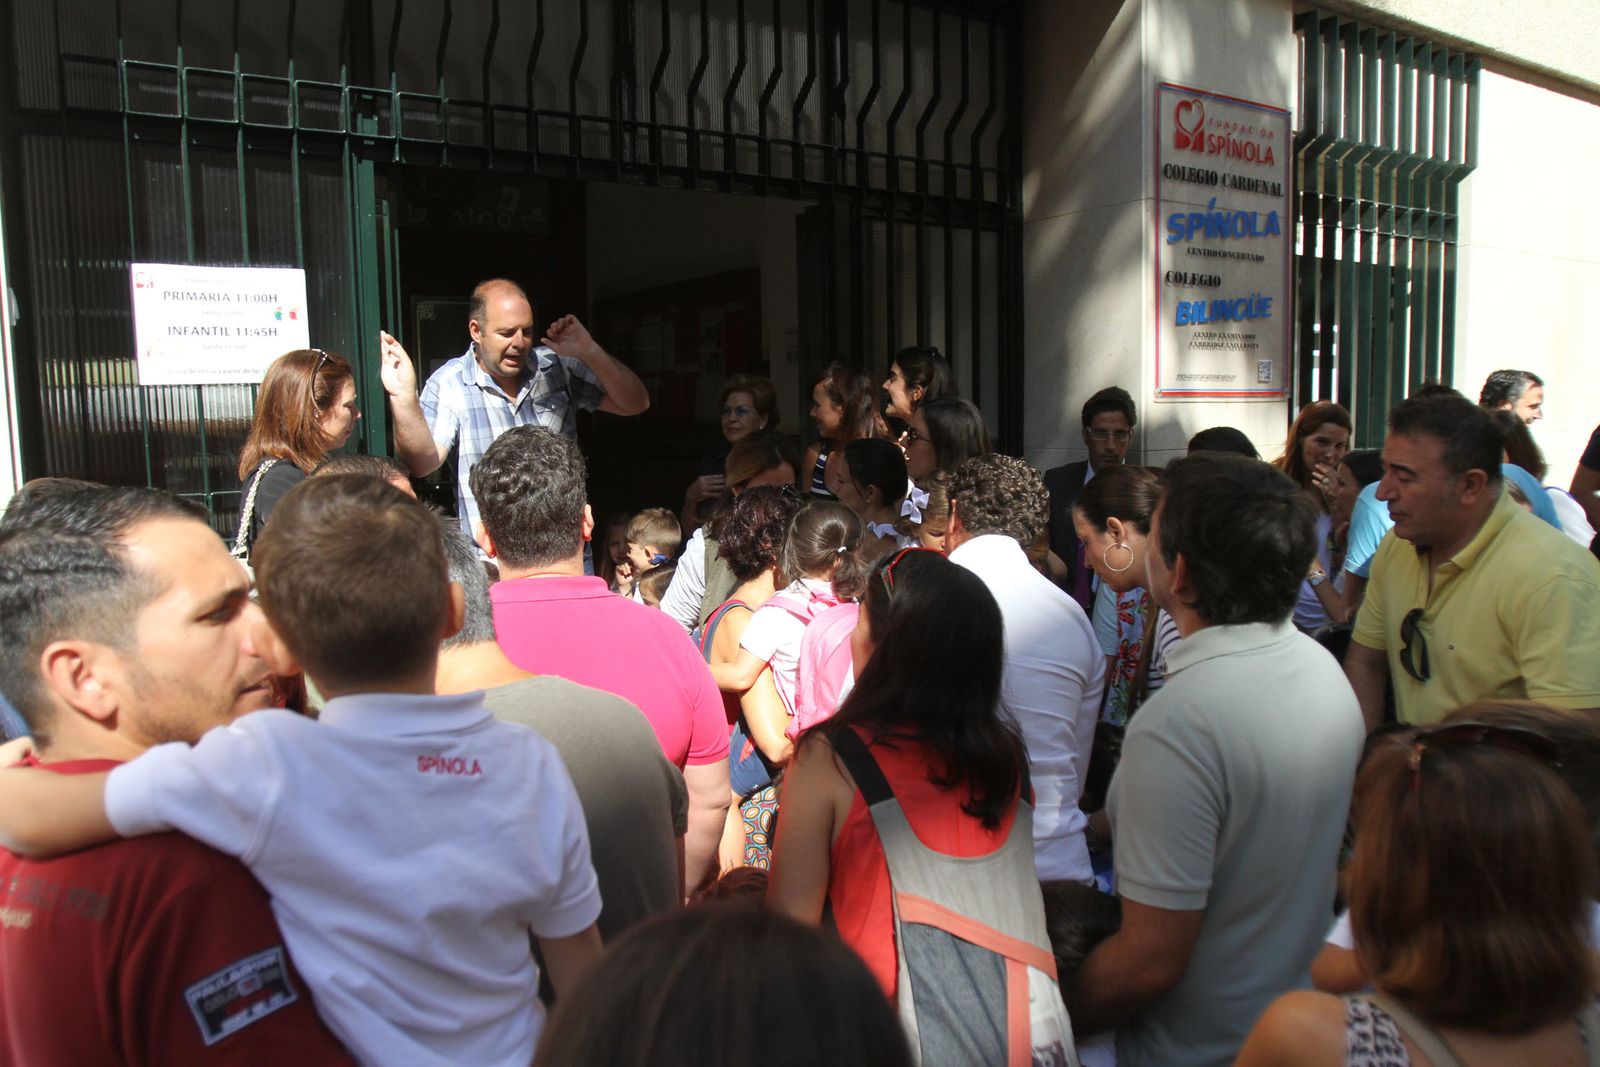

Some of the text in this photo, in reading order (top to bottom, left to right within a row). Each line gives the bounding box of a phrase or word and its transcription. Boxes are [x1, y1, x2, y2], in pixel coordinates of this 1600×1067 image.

[1207, 133, 1275, 165] SPÍNOLA
[1164, 164, 1284, 197] COLEGIO CARDENAL
[1167, 197, 1280, 244] SPÍNOLA
[1187, 247, 1265, 262] CENTRO CONCERTADO
[1166, 271, 1221, 287] COLEGIO
[163, 290, 277, 303] PRIMARIA 11:00H
[1176, 292, 1273, 326] BILINGÜE
[168, 326, 277, 337] INFANTIL 11:45H
